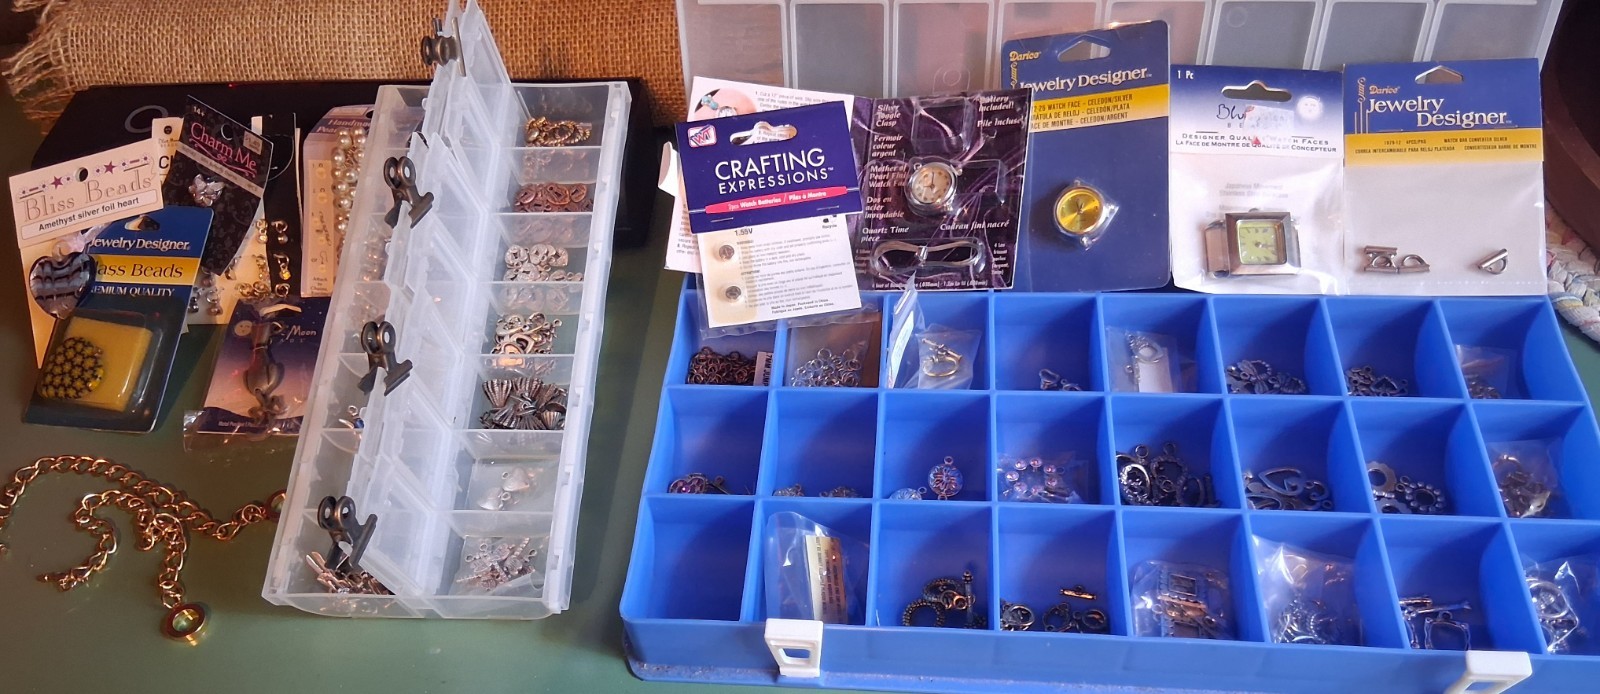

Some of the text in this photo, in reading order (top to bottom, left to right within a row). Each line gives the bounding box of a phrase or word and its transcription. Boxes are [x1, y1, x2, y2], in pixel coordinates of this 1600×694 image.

[1078, 67, 1148, 87] Designer
[1177, 70, 1181, 79] 1
[1047, 102, 1066, 111] WATCH
[1068, 100, 1081, 108] FACE
[1367, 96, 1445, 114] Jewelry
[876, 119, 897, 127] Clasp
[1031, 121, 1041, 130] ACE
[1051, 118, 1074, 127] MONTRE
[1416, 110, 1507, 129] Designer
[874, 134, 903, 142] Fermoir
[1182, 133, 1226, 141] DESIGNER
[1302, 138, 1329, 146] FACES
[191, 122, 233, 159] Charm
[234, 148, 257, 170] Me
[1291, 144, 1337, 152] CONCEPTEUR
[872, 150, 896, 158] argent
[715, 148, 825, 180] CRAFTING
[718, 168, 828, 195] EXPRESSIONS
[17, 169, 152, 222] Bliss Beads
[758, 197, 782, 205] Batteries
[38, 197, 139, 231] Amethyst silver foil heart
[862, 226, 910, 235] Quartz Time
[940, 222, 969, 231] Cadran
[987, 219, 1010, 229] nacré
[734, 228, 753, 236] 1.55V
[89, 237, 189, 251] Jewelry Designer
[95, 261, 183, 278] ass Beads
[91, 285, 175, 298] EMIUM QUALITY
[285, 324, 317, 340] Moon
